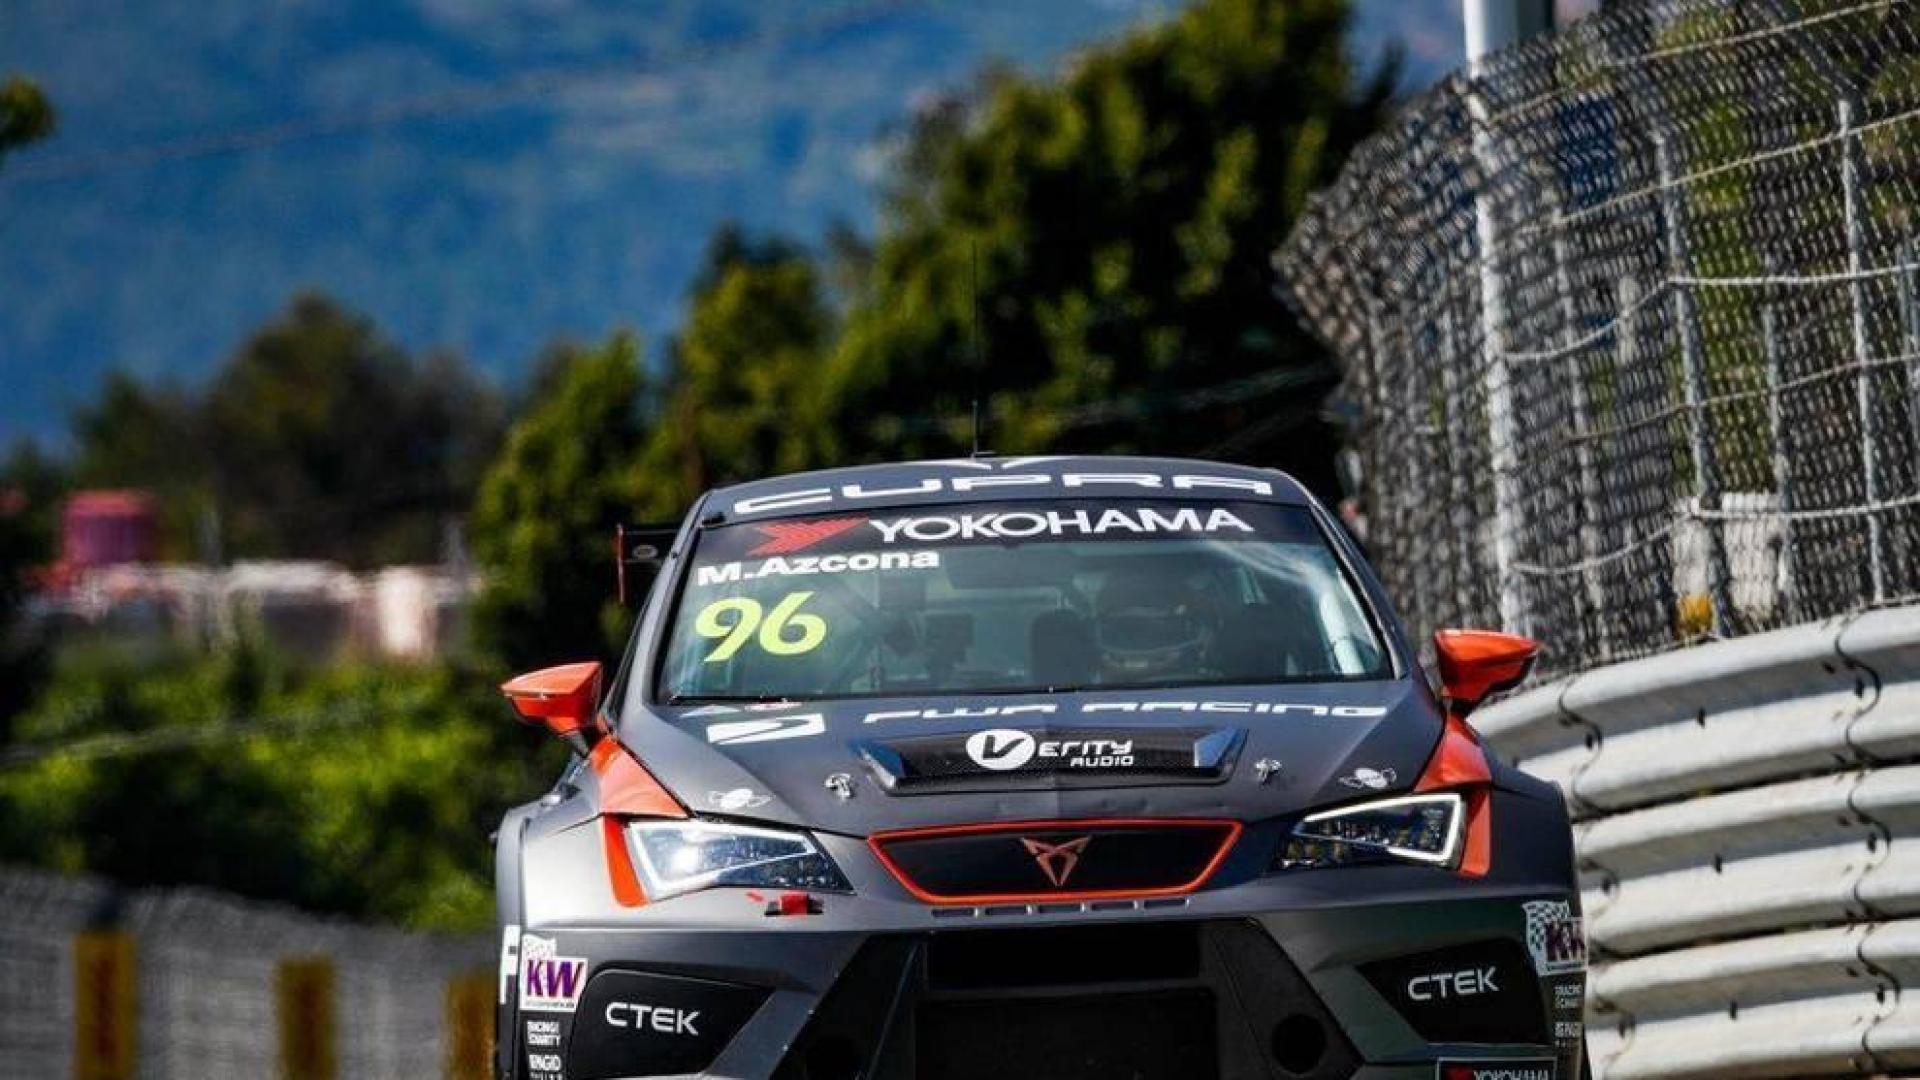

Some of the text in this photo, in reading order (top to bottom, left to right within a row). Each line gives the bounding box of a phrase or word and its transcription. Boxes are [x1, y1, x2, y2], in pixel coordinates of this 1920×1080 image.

[735, 473, 1273, 514] CUPRA
[868, 508, 1255, 543] YOKOHAMA
[698, 550, 939, 586] M.Azcona
[695, 590, 827, 662] 96
[1070, 755, 1134, 767] AUDIO
[527, 959, 585, 998] KW
[1407, 966, 1499, 1001] CTEK
[606, 1002, 699, 1036] CTEK
